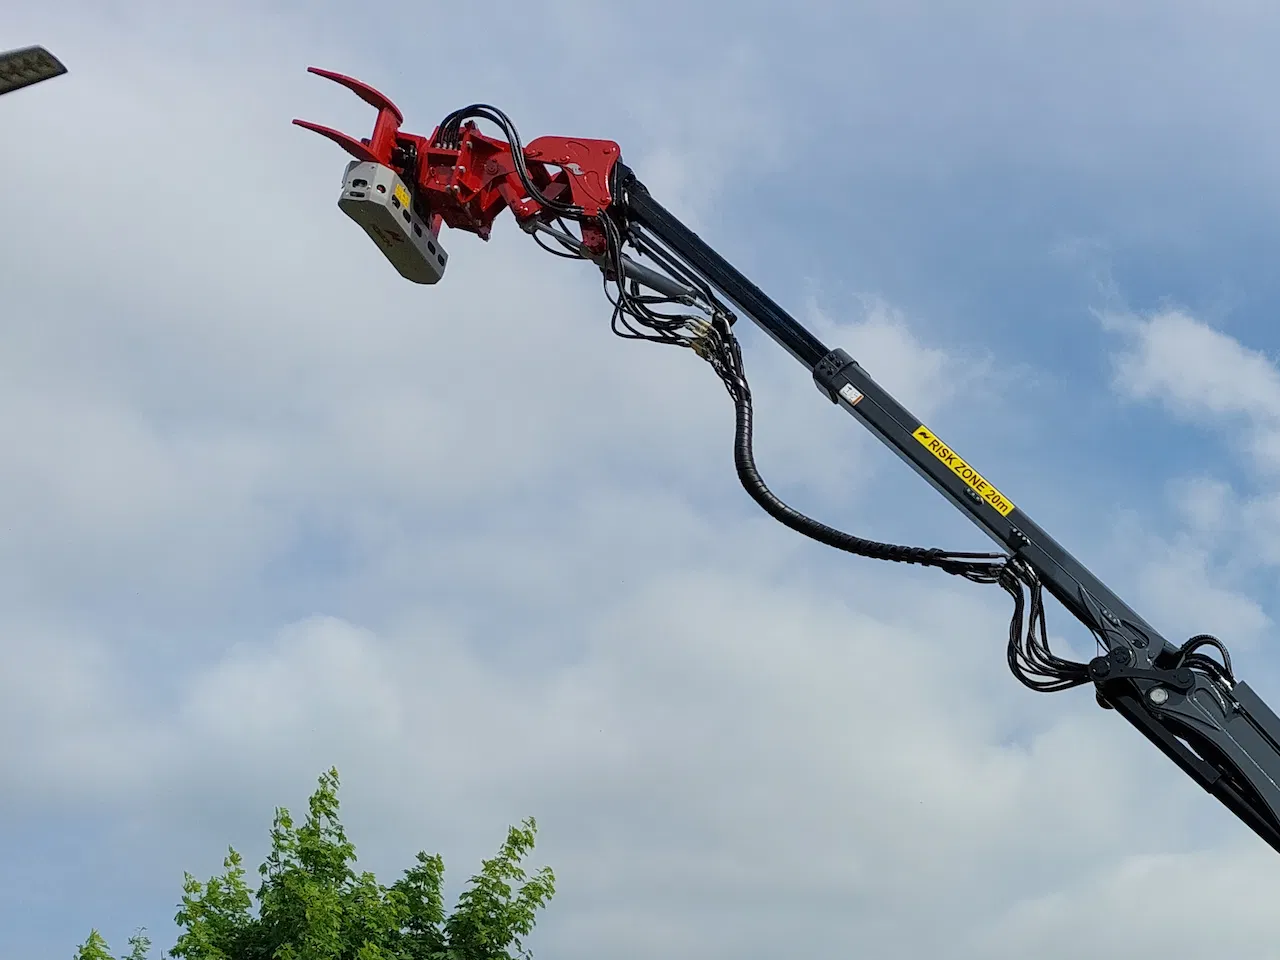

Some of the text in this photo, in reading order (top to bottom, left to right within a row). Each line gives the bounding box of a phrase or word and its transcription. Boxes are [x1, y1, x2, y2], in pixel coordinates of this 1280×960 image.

[928, 439, 1009, 513] RISK ZONE 20m
